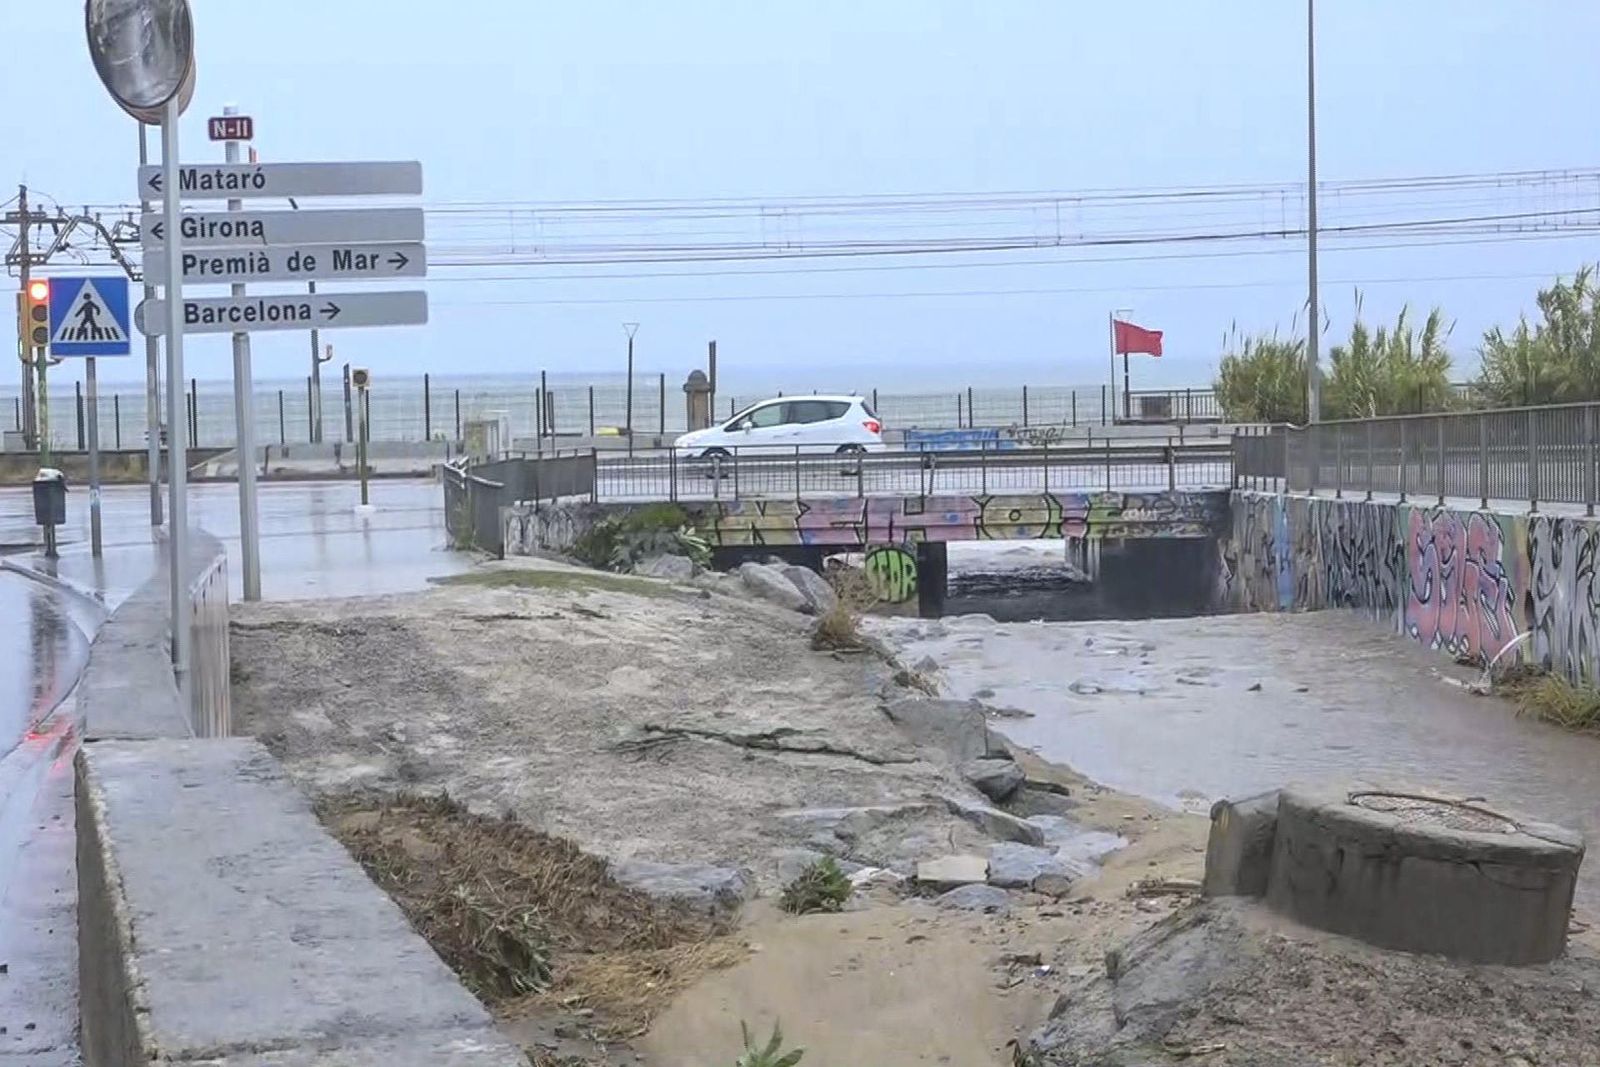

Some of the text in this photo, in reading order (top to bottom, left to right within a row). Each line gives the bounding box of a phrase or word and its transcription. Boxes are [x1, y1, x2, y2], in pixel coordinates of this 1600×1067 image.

[213, 119, 249, 137] N-II
[178, 167, 266, 191] Mataró
[180, 216, 265, 238] Girona
[182, 249, 380, 276] Premià de Mar
[184, 301, 312, 325] Barcelona
